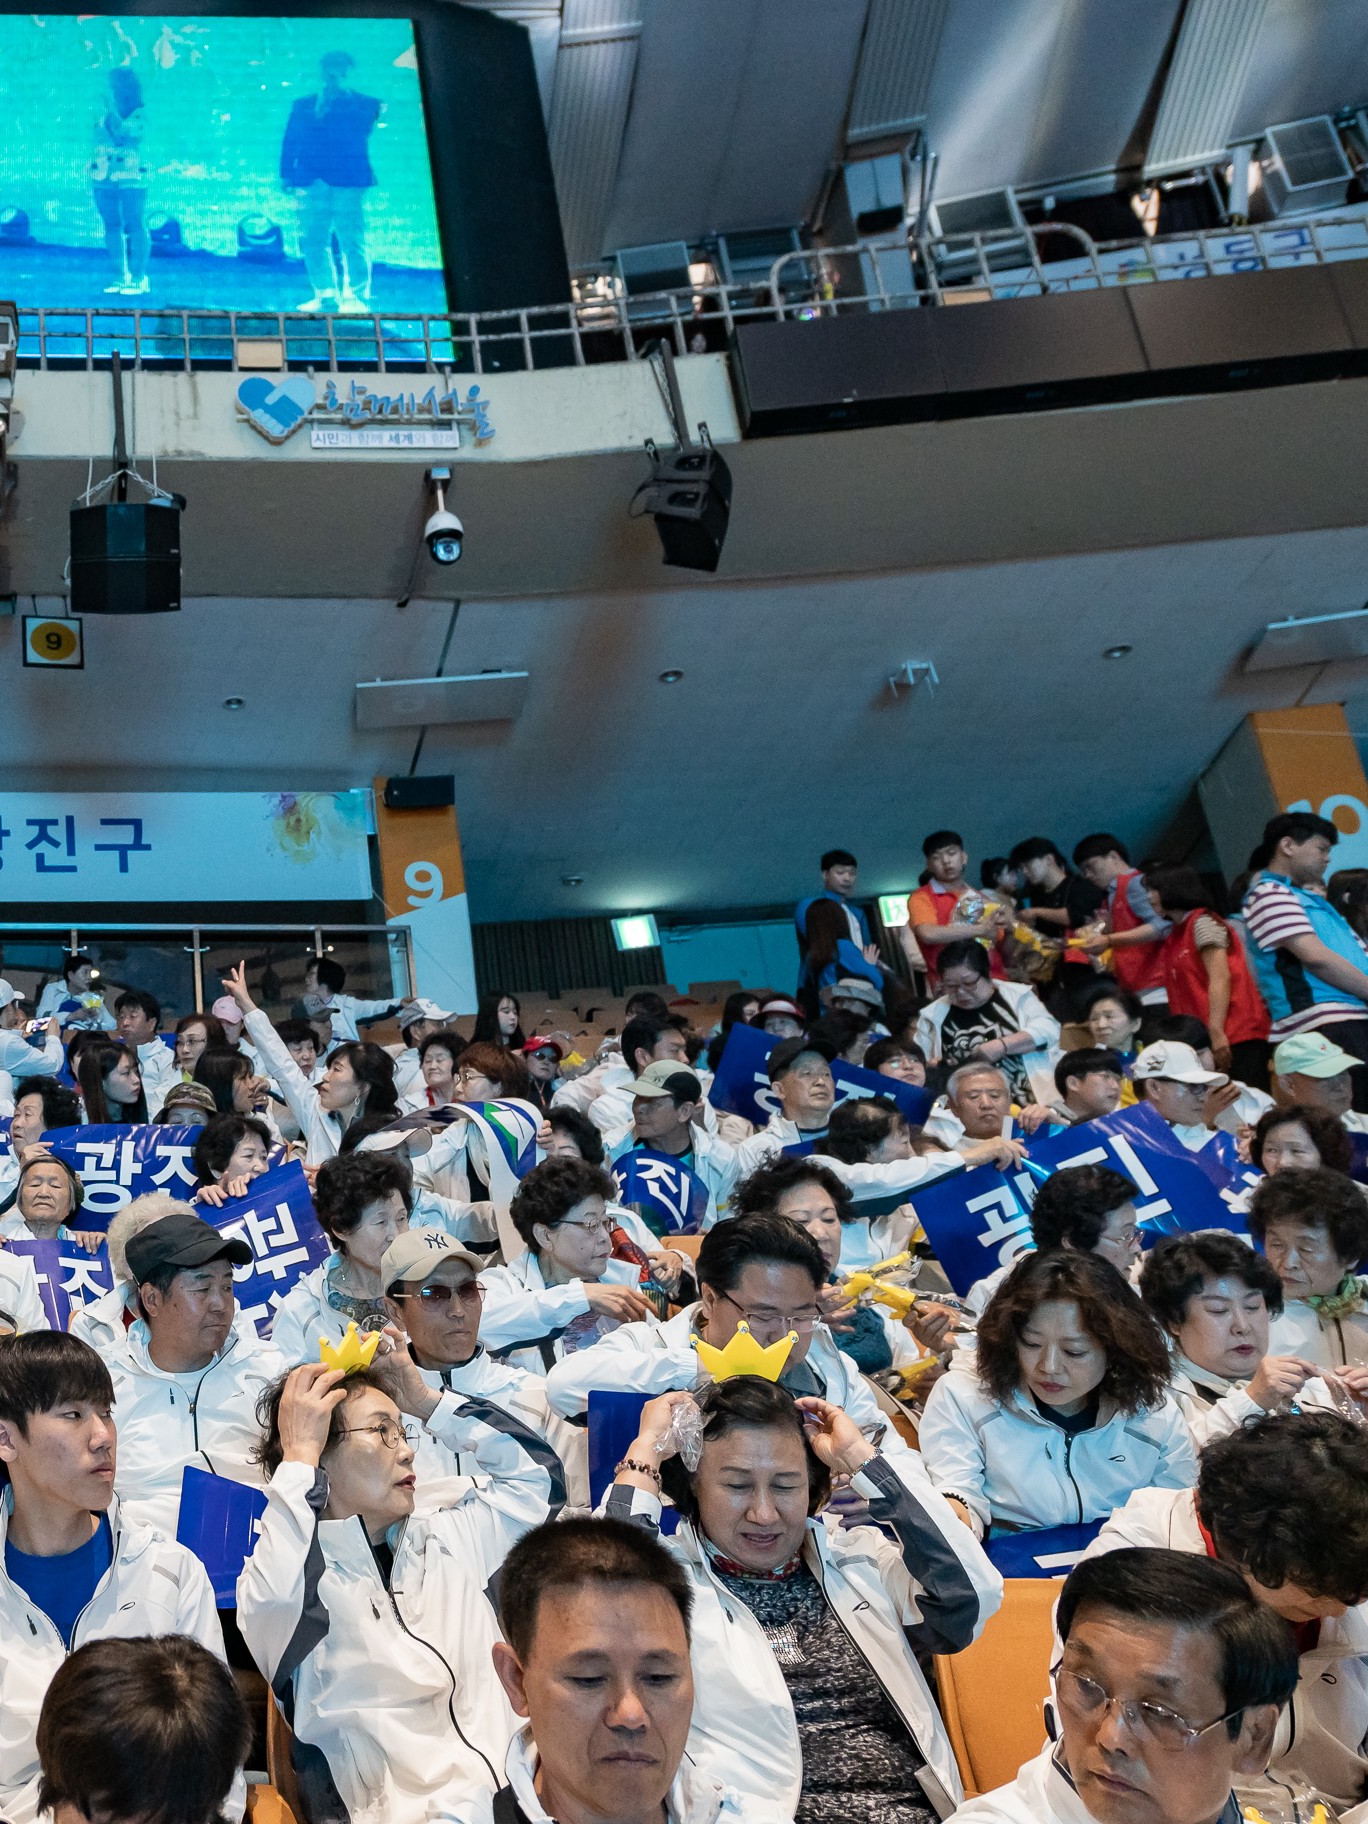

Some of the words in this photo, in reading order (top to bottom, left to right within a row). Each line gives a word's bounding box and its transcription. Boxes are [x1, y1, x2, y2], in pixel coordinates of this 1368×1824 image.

[314, 431, 352, 446] 시민과
[359, 431, 383, 446] 함께
[389, 431, 427, 447] 세계와
[432, 432, 458, 447] 함께
[45, 632, 62, 650] 9
[404, 860, 445, 908] 9
